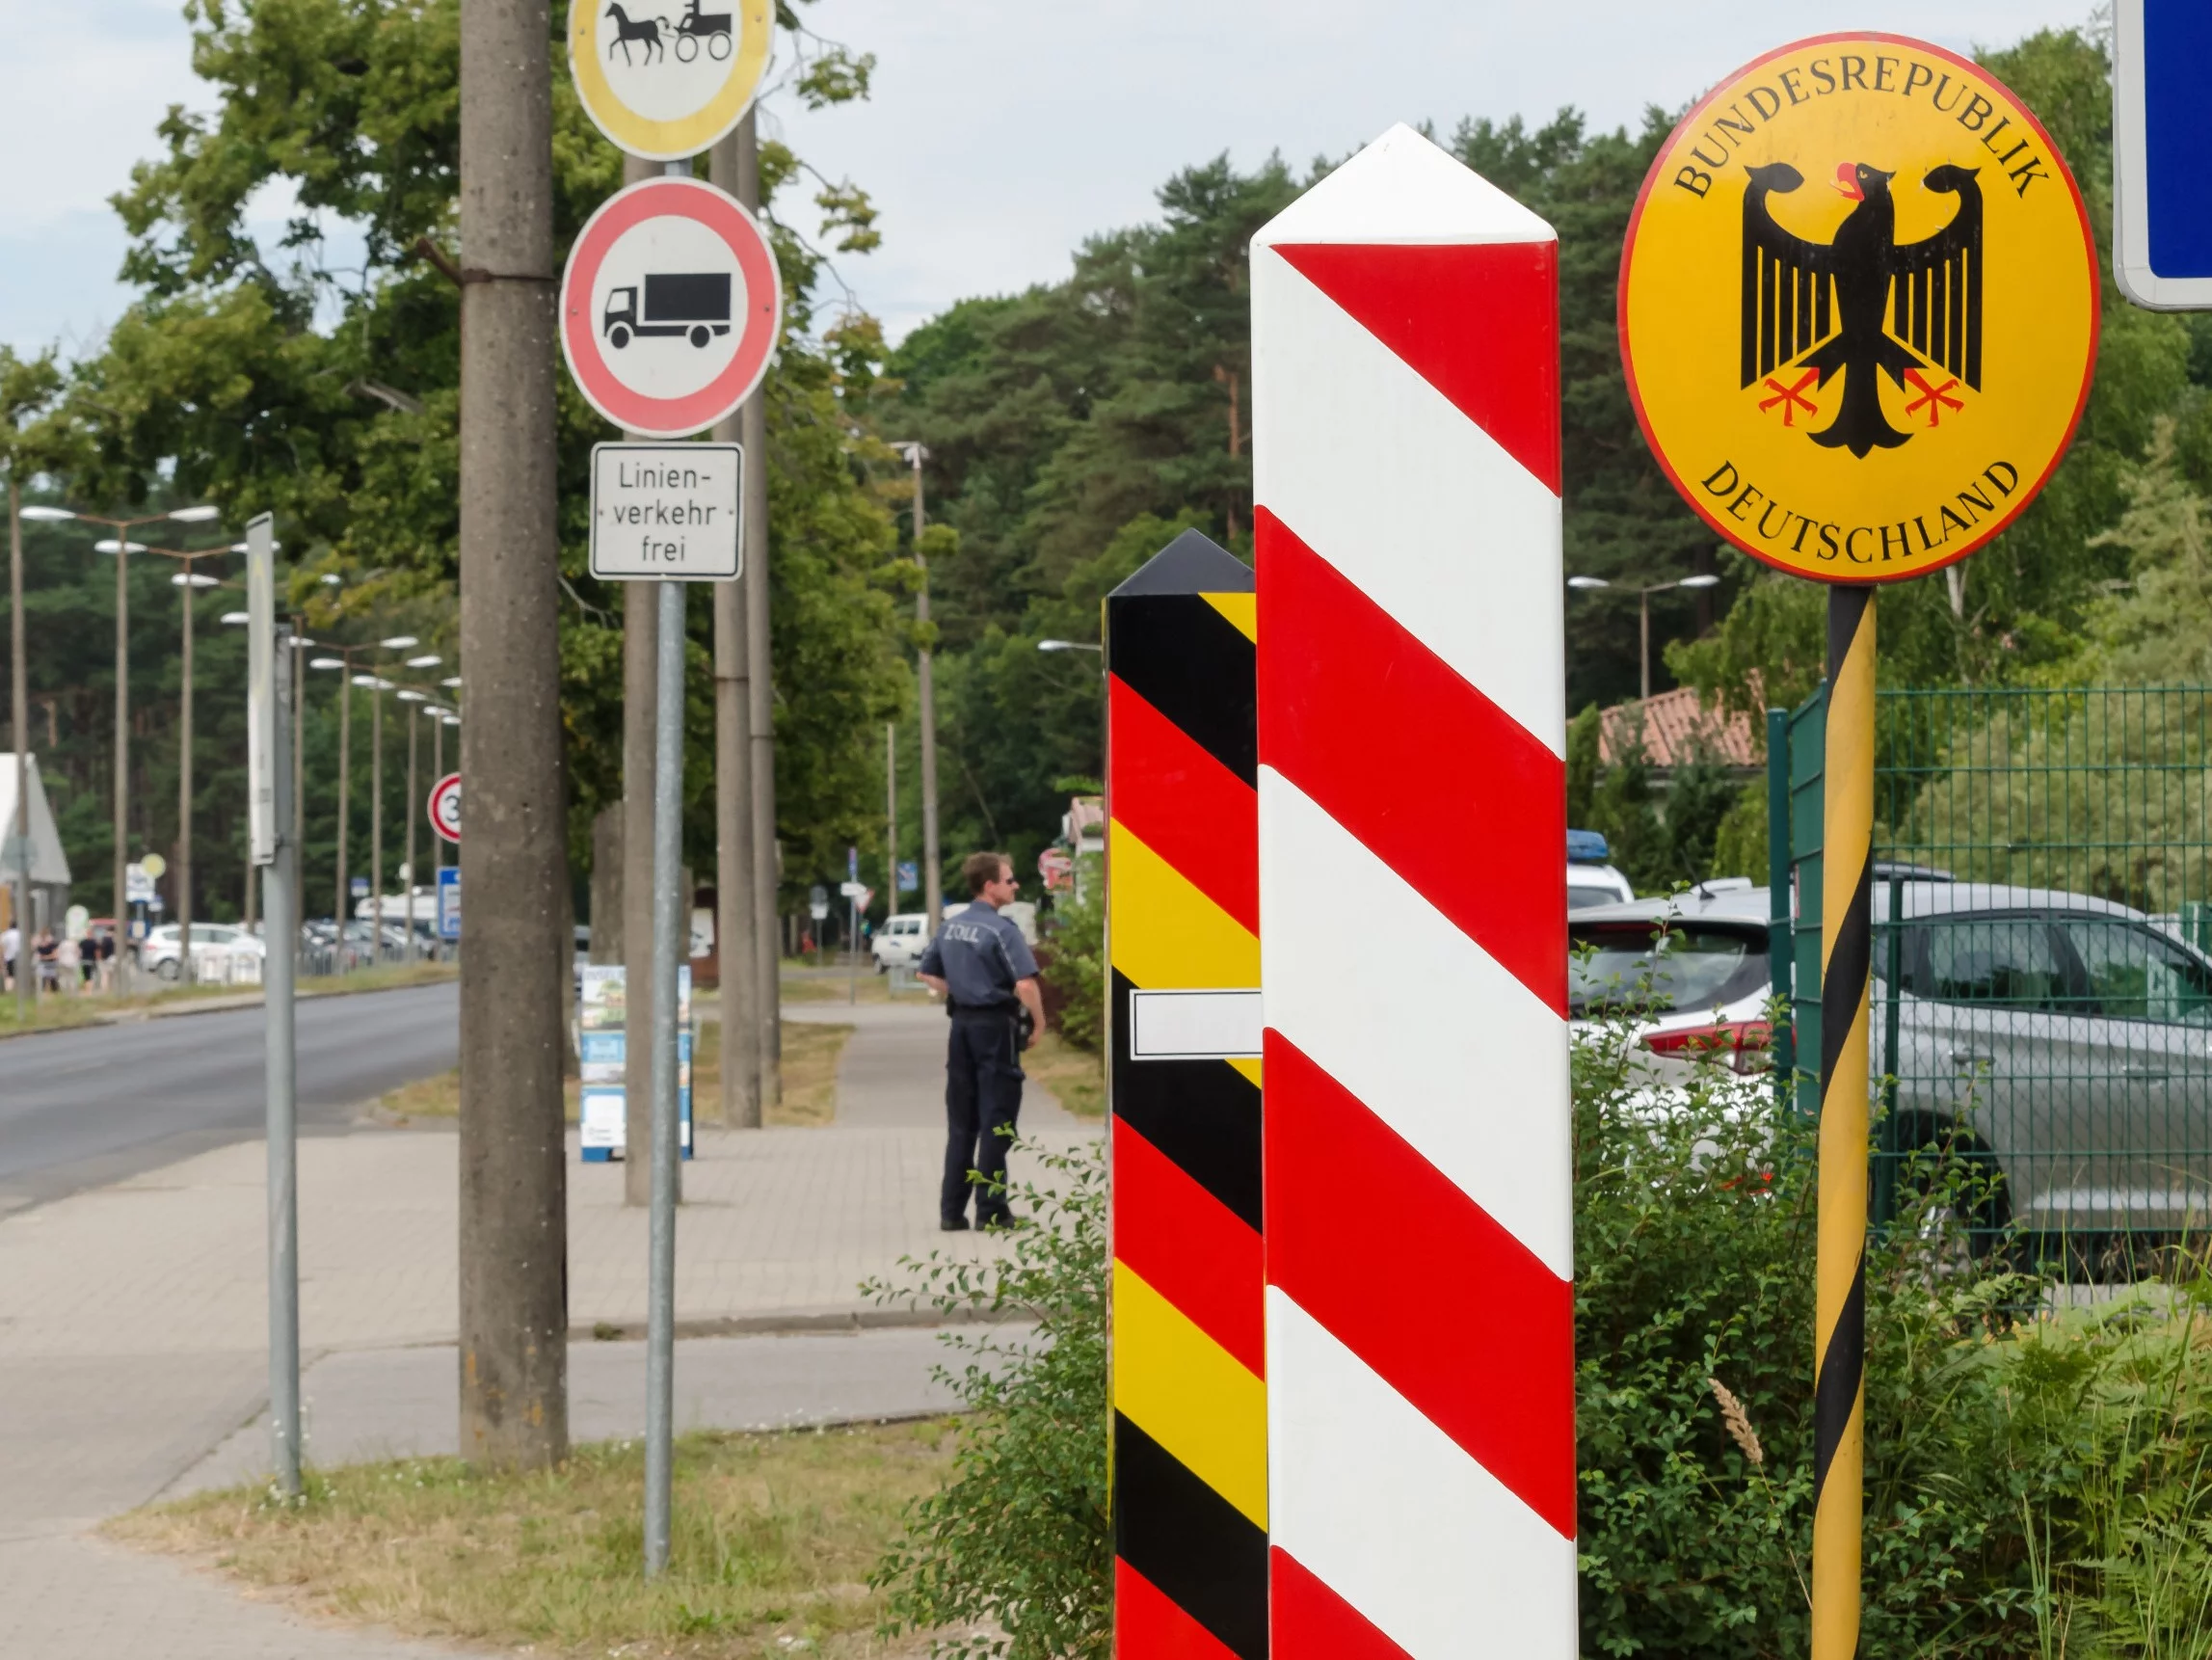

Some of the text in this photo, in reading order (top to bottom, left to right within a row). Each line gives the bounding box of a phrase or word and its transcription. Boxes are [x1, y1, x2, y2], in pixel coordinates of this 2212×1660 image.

[1673, 55, 2050, 199] BUNDESREPUBLIK
[619, 462, 711, 489] Linien-
[613, 498, 717, 525] verkehr
[1700, 460, 2019, 564] DEUTSCHLAND
[642, 535, 685, 562] frei
[444, 793, 461, 821] 3
[944, 924, 979, 944] ZOLL
